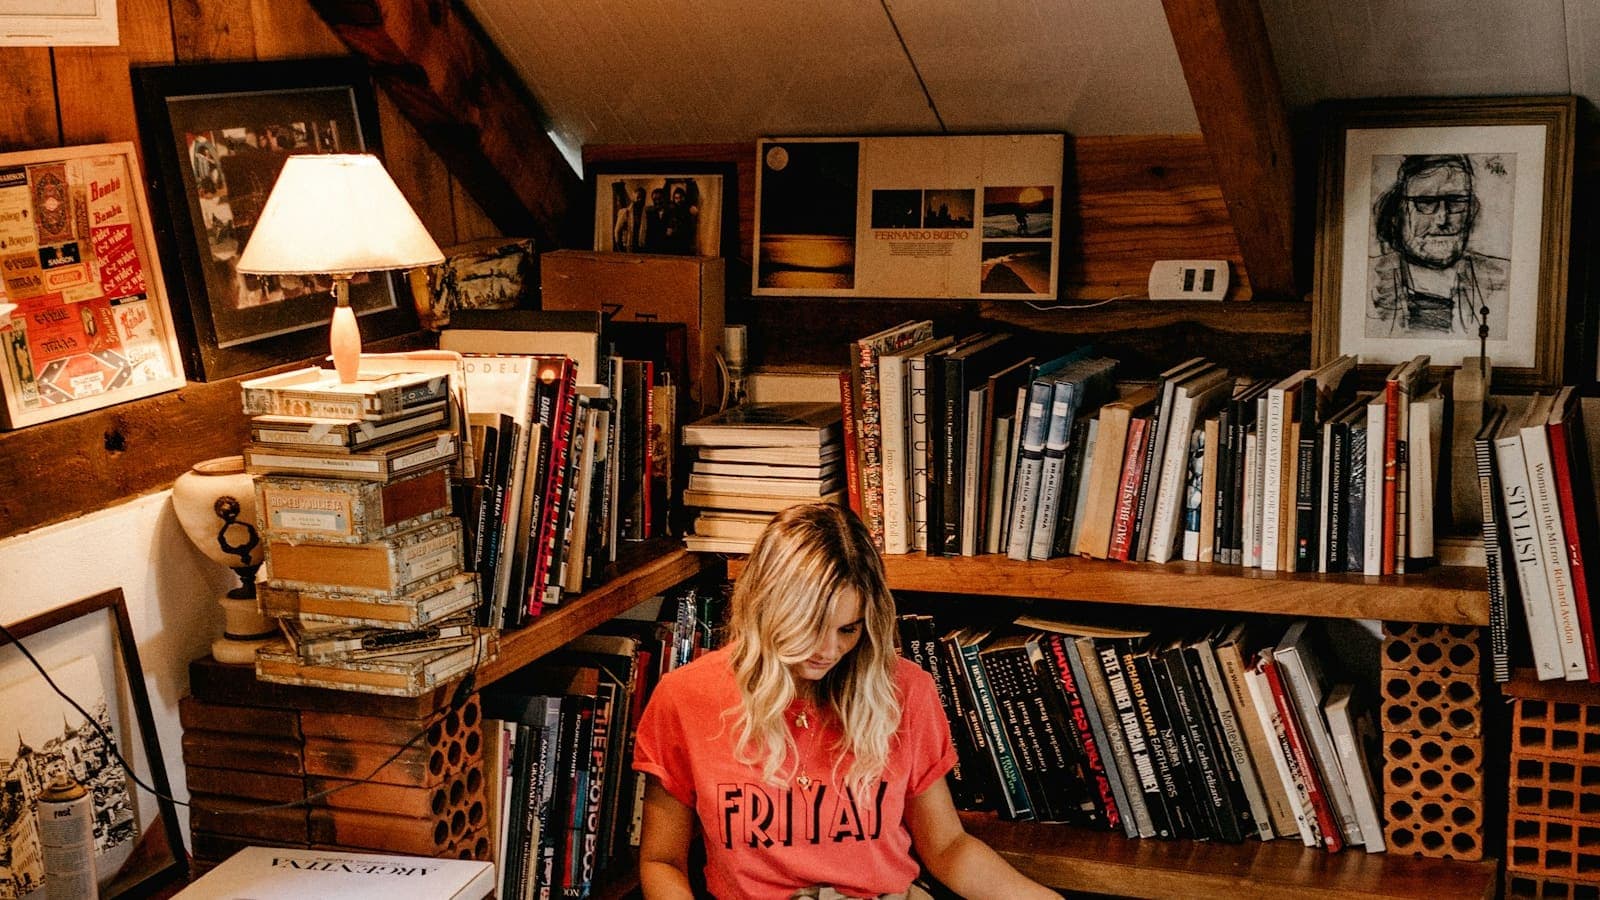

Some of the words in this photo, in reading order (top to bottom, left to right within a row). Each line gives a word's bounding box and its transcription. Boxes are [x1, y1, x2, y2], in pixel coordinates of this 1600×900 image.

[0, 172, 25, 180] AMSON
[874, 230, 931, 241] FERNANDO
[933, 230, 970, 241] BUENO
[48, 255, 75, 266] SAMSON
[1269, 394, 1279, 442] RICHARD
[1268, 447, 1277, 486] AVEDON
[1535, 463, 1549, 500] Woman
[1117, 482, 1133, 542] PAU-BRASIL
[1265, 490, 1276, 545] PORTRAITS
[1542, 502, 1551, 513] in
[1544, 514, 1554, 531] the
[1505, 485, 1537, 567] STYLIST
[1547, 532, 1560, 565] Mirror
[1554, 568, 1567, 607] Richard
[1561, 609, 1574, 643] Avedon
[1100, 648, 1118, 674] PETE
[1108, 672, 1131, 709] TURNER
[1002, 699, 1017, 724] Brasil
[1017, 700, 1030, 725] Brasil
[1034, 696, 1048, 721] Brasil
[1123, 654, 1142, 697] RICHARD
[1138, 698, 1155, 736] KALVAR
[1151, 737, 1175, 796] EARTHLINGS
[1012, 725, 1021, 737] do
[1026, 726, 1034, 738] do
[1043, 722, 1052, 734] do
[1108, 722, 1124, 756] WOMEN
[1121, 710, 1145, 752] AFRICAN
[1221, 709, 1246, 766] Montevideo
[1135, 751, 1159, 795] JOURNEY
[1189, 723, 1201, 743] Luiz
[1196, 742, 1210, 769] Carlos
[1205, 769, 1222, 807] Felizardo
[717, 778, 888, 849] FRIYAY
[271, 857, 438, 877] ARGENTINA
